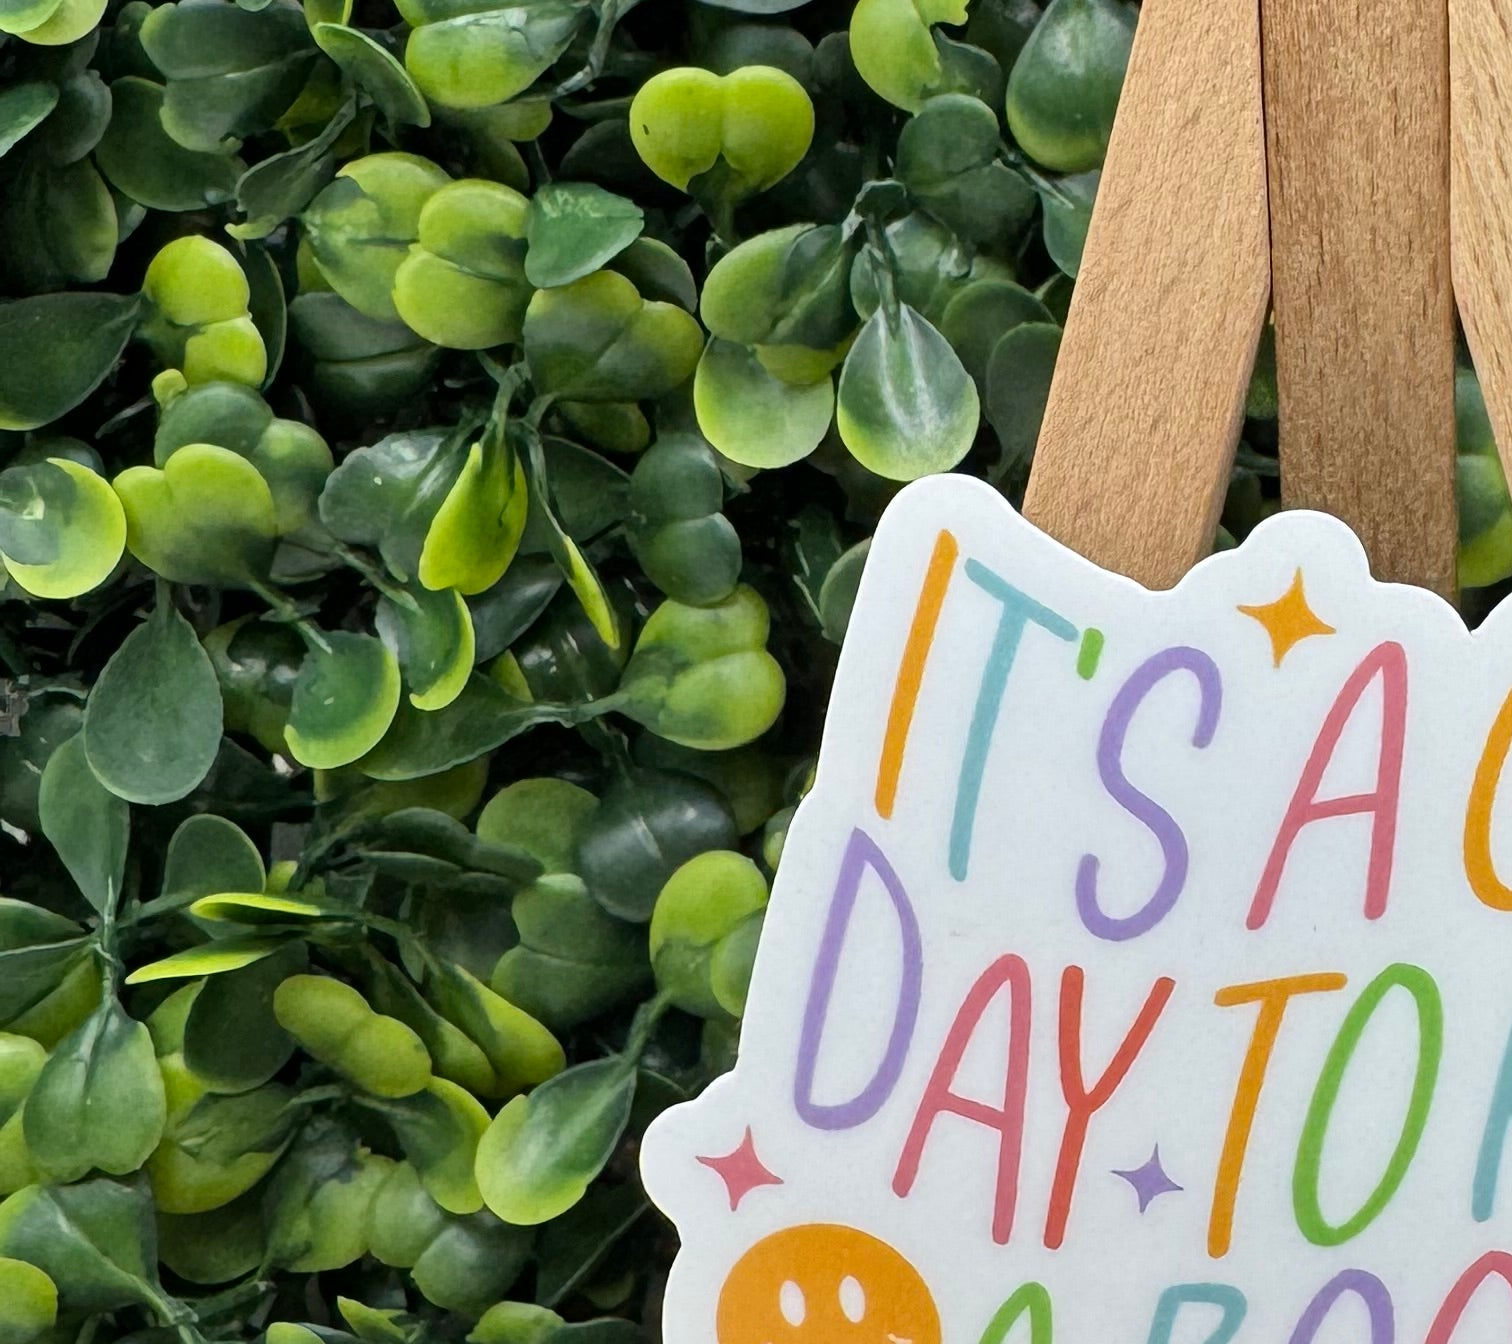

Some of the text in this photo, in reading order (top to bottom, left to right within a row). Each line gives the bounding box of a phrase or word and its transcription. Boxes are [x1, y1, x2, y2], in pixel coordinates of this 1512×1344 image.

[876, 529, 1222, 941] IT'S
[1249, 641, 1408, 930] A
[798, 829, 1176, 1250] DAY
[1206, 964, 1444, 1260] TO
